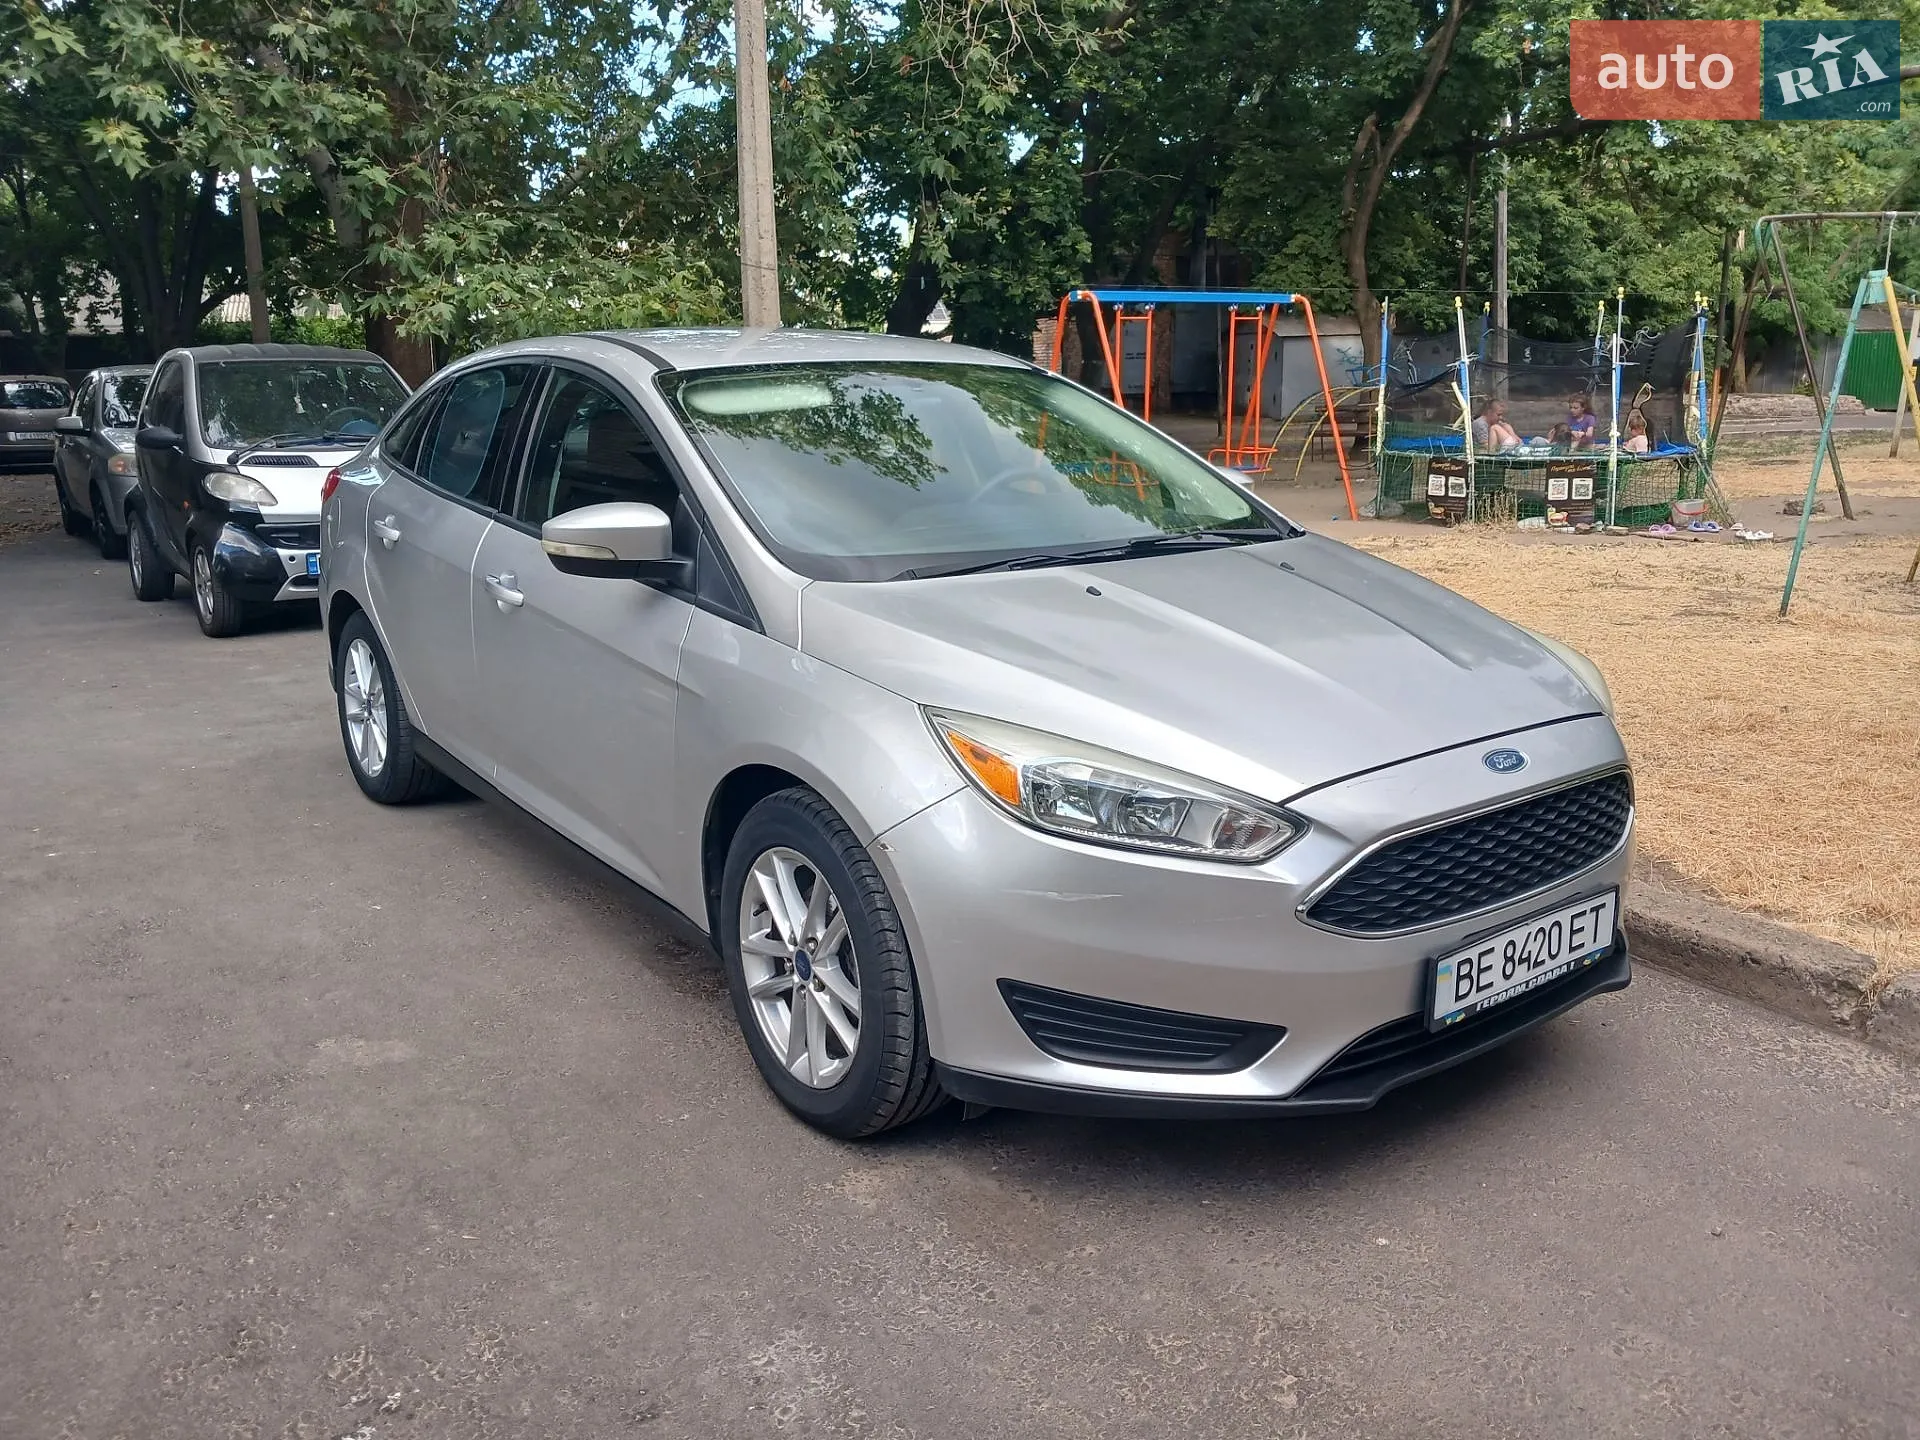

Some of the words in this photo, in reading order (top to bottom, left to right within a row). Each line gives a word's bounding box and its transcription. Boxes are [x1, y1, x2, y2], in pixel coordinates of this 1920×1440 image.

[1493, 754, 1517, 769] Ford
[1454, 946, 1496, 1004] BE
[1501, 919, 1563, 981] 8420
[1568, 902, 1607, 954] ET
